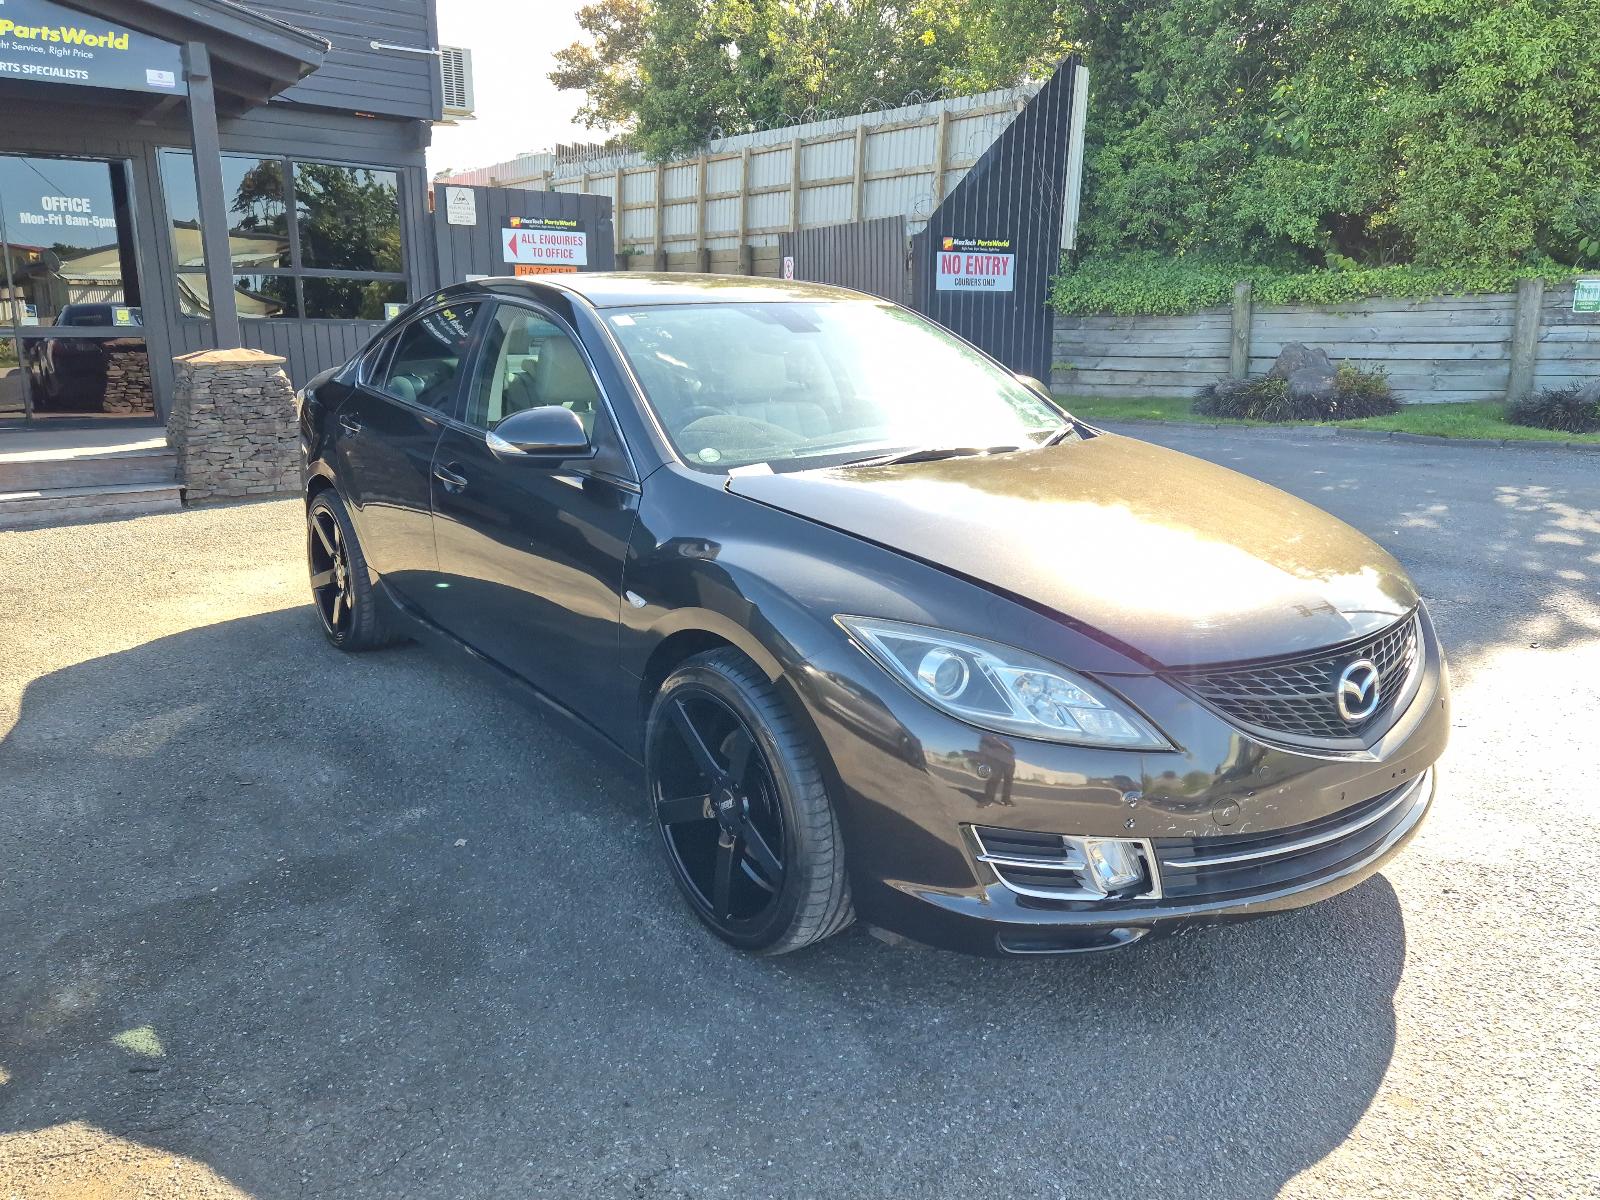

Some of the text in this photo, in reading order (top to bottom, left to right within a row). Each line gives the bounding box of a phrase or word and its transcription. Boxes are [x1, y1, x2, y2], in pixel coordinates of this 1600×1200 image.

[0, 19, 129, 50] PartsWorld
[12, 41, 46, 55] Service,
[49, 45, 71, 57] Right
[72, 48, 94, 59] Price
[22, 64, 89, 80] SPECIALISTS
[41, 196, 92, 213] OFFICE
[19, 212, 116, 229] Mon-Fri 8am-5pm
[544, 219, 577, 227] PartsWorld
[521, 233, 584, 246] ALL ENQUIRIES
[977, 239, 1010, 248] PartsWorld
[532, 247, 574, 259] TO OFFICE
[941, 254, 1009, 276] NO ENTRY
[954, 277, 996, 287] COURIERS ONLY
